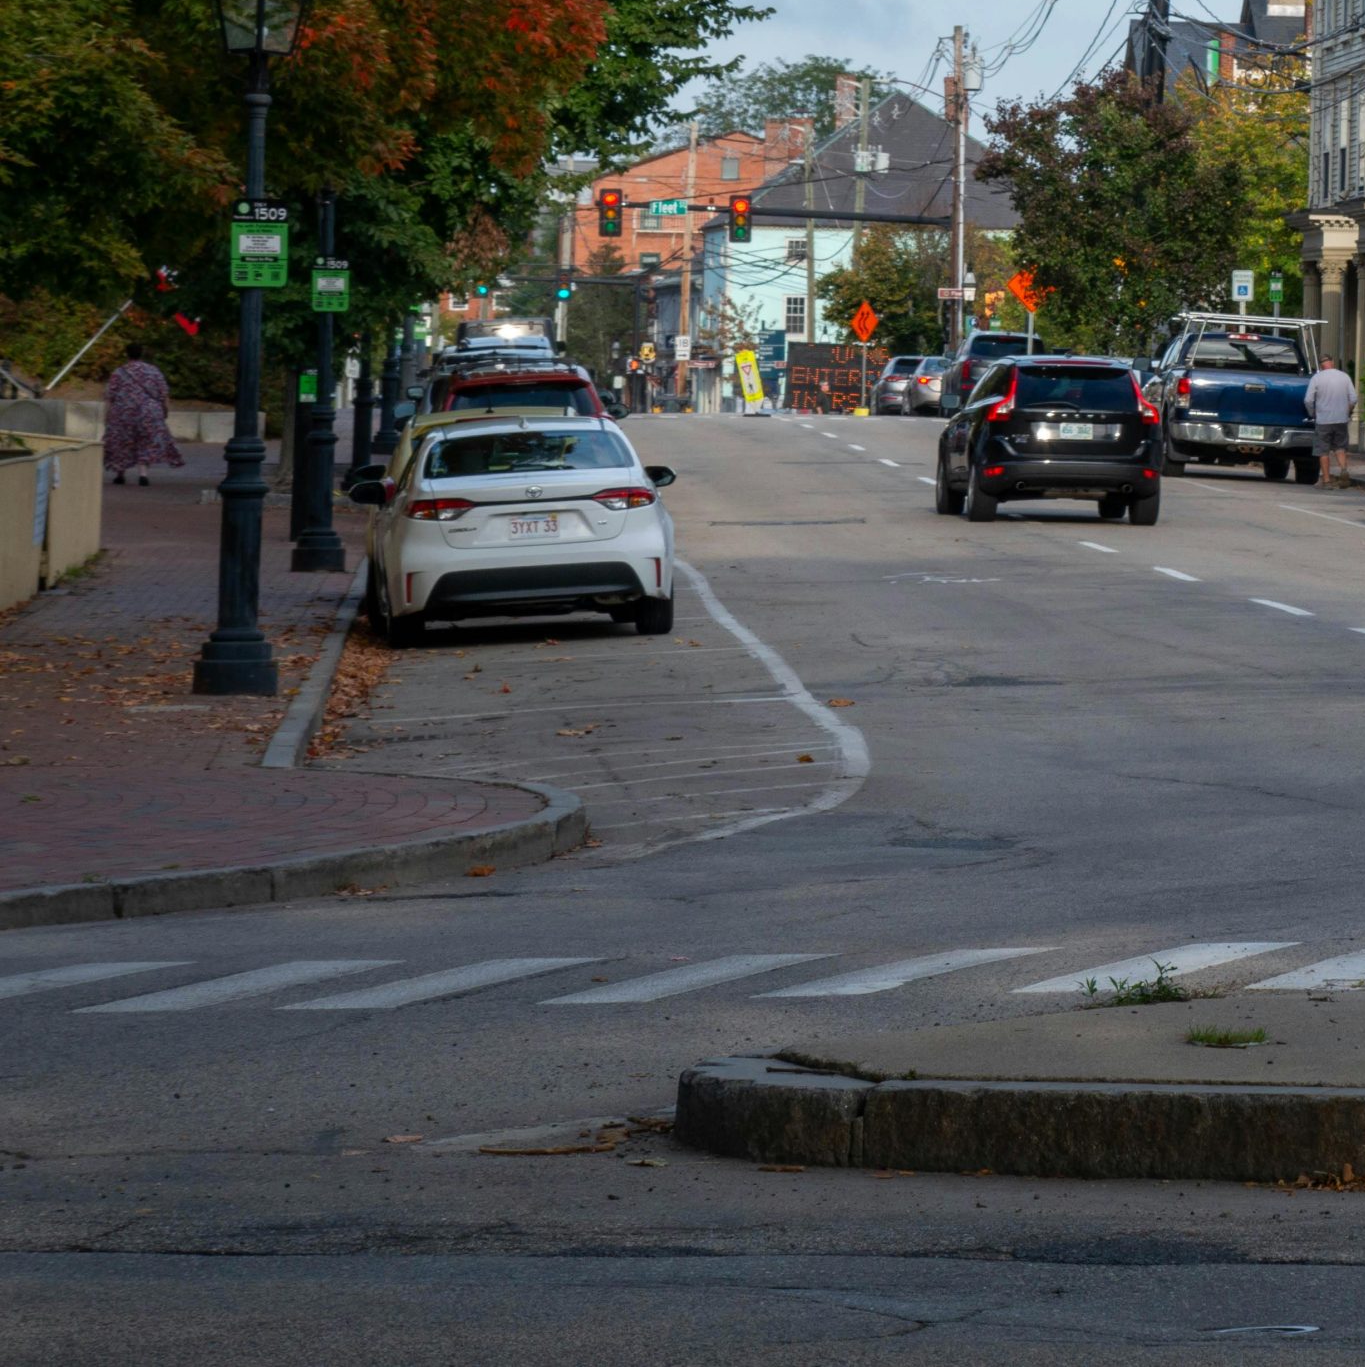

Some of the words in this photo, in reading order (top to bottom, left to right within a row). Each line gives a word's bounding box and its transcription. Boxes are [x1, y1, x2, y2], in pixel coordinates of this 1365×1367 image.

[652, 201, 678, 214] Fleet
[254, 208, 288, 221] 1509
[511, 520, 539, 535] 3YXT
[543, 519, 559, 533] 33
